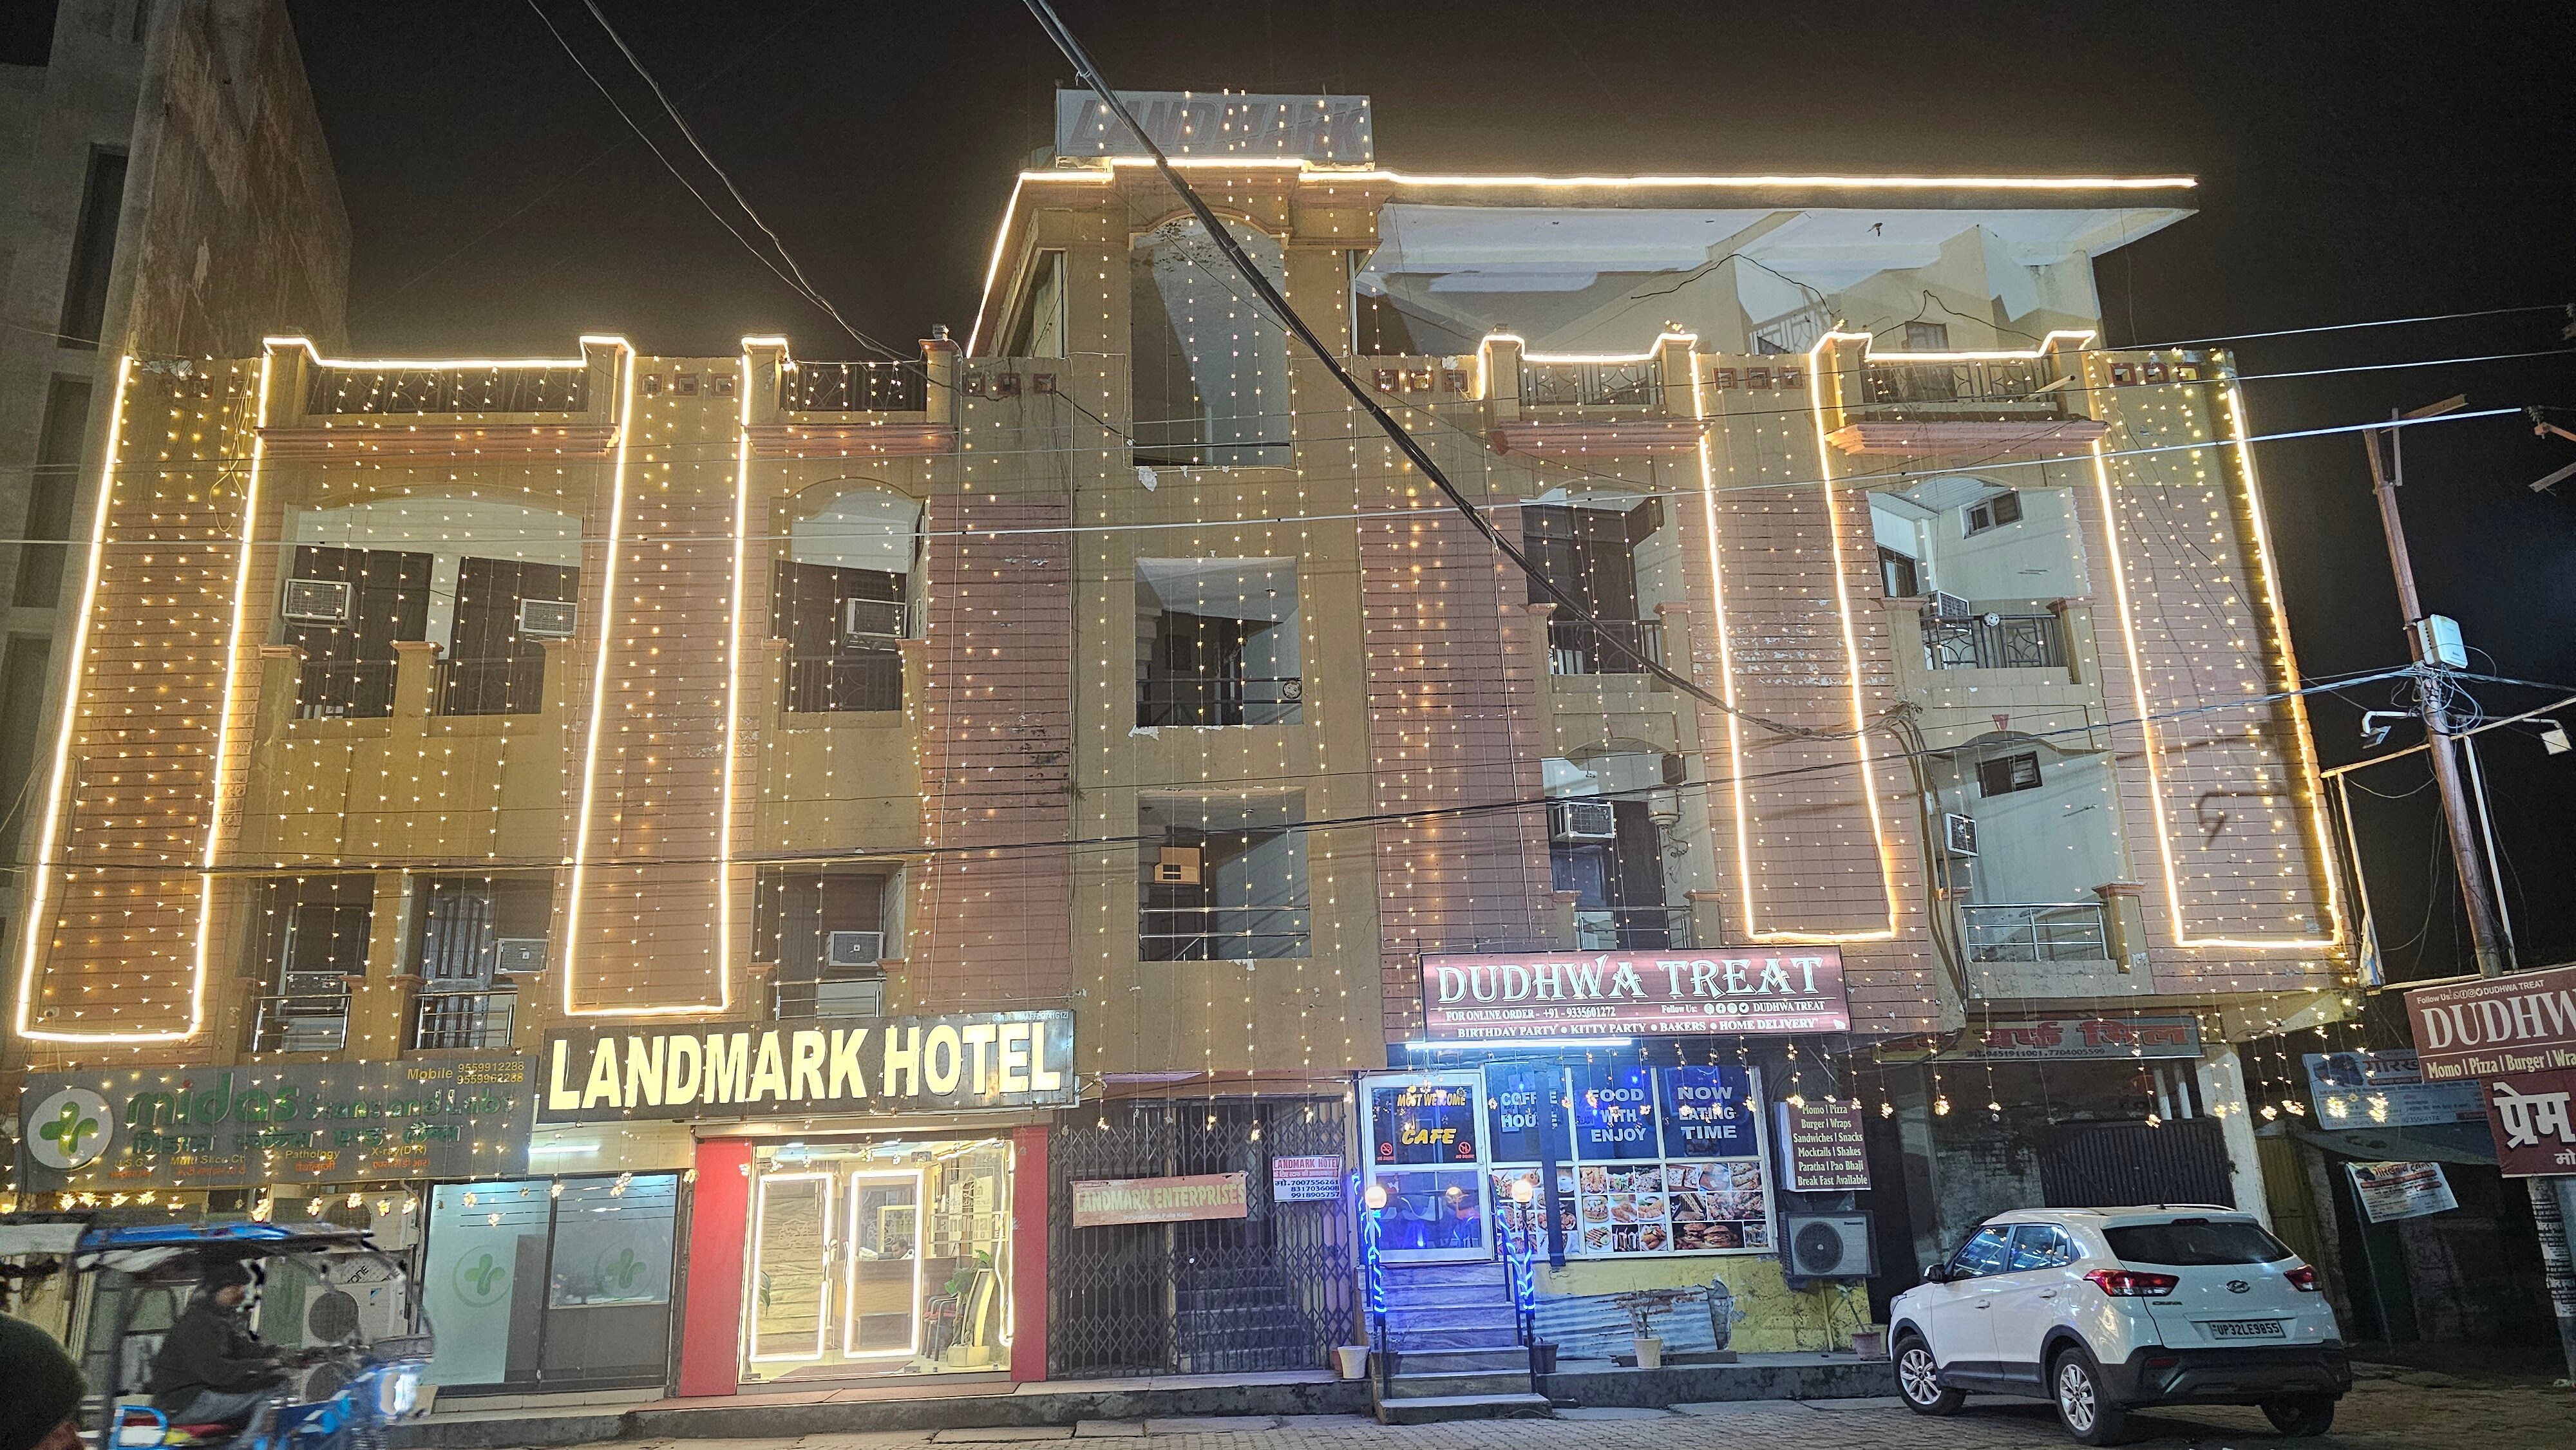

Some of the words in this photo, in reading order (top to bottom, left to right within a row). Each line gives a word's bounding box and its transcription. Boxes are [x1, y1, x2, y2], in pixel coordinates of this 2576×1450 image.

[1067, 98, 1369, 158] LANDMARK
[1437, 954, 1649, 1003] DUDHWA
[1656, 956, 1824, 1000] TREAT
[2484, 985, 2518, 995] DUDHWA
[2518, 979, 2544, 990] TREAT
[1753, 1001, 1794, 1012] DUDHWA
[1795, 1000, 1825, 1011] TREAT
[2417, 995, 2439, 1004] Follow
[1446, 1010, 1465, 1022] FOR
[1466, 1010, 1502, 1021] ONLINE
[1502, 1008, 1535, 1019] ORDER
[1543, 1008, 1560, 1019] +91
[1662, 1004, 1685, 1013] Follow
[1570, 1023, 1608, 1034] KITTY
[1609, 1022, 1647, 1033] PARTY
[1660, 1021, 1707, 1032] BAKERS
[1719, 1019, 1756, 1030] HOME
[1757, 1017, 1816, 1030] DELIVERY
[1457, 1026, 1518, 1038] BIRTHDAY
[1519, 1025, 1557, 1036] PARTY
[549, 1028, 869, 1111] LANDMARK
[883, 1021, 1061, 1097] HOTEL
[2427, 1062, 2462, 1078] Momo
[2468, 1057, 2499, 1075] Pizza
[2505, 1054, 2544, 1072] Burger
[407, 1068, 453, 1080] Mobile
[126, 1071, 300, 1125] midas
[1501, 1091, 1558, 1106] COFFE
[1589, 1089, 1644, 1102] FOOD
[1678, 1087, 1732, 1100] NOW
[1678, 1106, 1736, 1120] EATING
[1803, 1104, 1824, 1115] Momo
[1830, 1104, 1848, 1114] Pizza
[2493, 1082, 2576, 1149] प्रेम
[1801, 1119, 1825, 1130] Burger
[1830, 1118, 1852, 1129] Wraps
[1401, 1128, 1457, 1145] CAFE
[1591, 1127, 1647, 1142] ENJOY
[1681, 1125, 1738, 1140] TIME
[1793, 1133, 1833, 1143] Sandwiches
[1839, 1132, 1863, 1142] Snacks
[285, 1149, 340, 1160] Pathology
[1797, 1147, 1832, 1157] Mocktails
[1837, 1146, 1861, 1156] Shakes
[1274, 1158, 1315, 1169] LANDMARK
[1318, 1158, 1340, 1168] HOTEL
[1799, 1161, 1825, 1171] Paratha
[1830, 1162, 1844, 1171] Pao
[1845, 1160, 1864, 1172] Bhaji
[1797, 1176, 1818, 1186] Break
[1819, 1175, 1834, 1185] Fast
[1836, 1174, 1868, 1185] Available
[1075, 1189, 1151, 1213] LANDMARK
[1153, 1183, 1245, 1209] ENTERPRISES
[933, 1214, 1005, 1232] Landmark
[2217, 1322, 2280, 1336] UP32LE9855
